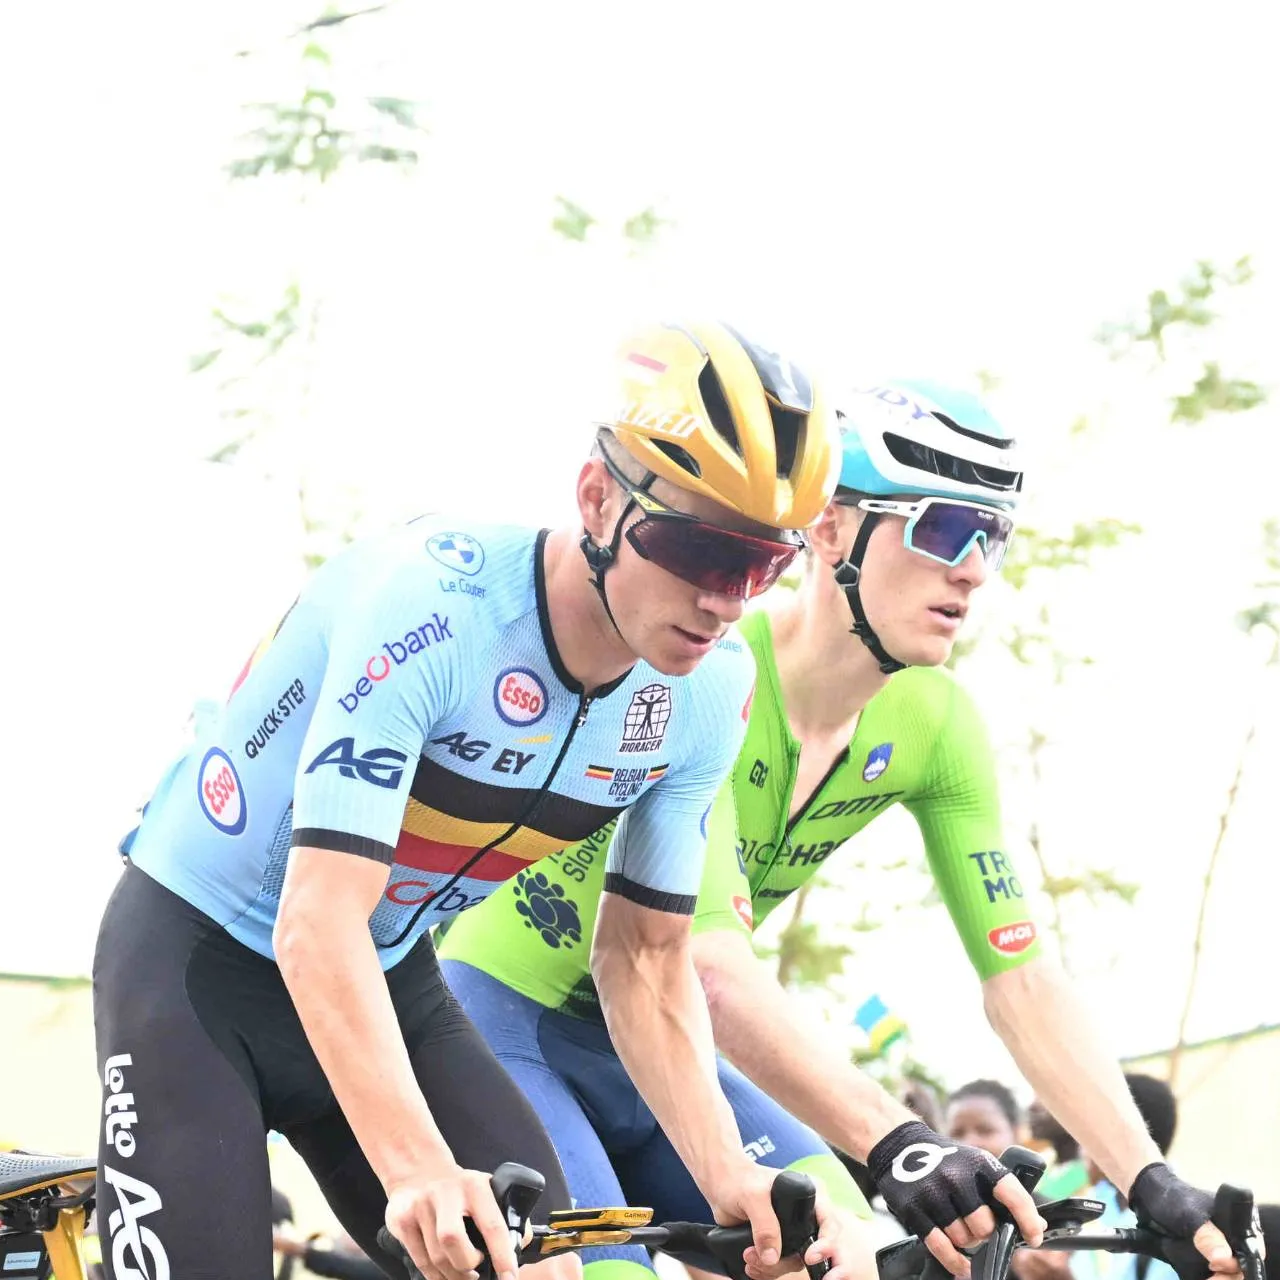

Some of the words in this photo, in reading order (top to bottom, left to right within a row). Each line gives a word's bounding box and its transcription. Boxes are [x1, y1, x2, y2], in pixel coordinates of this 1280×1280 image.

[439, 579, 456, 592] Le
[502, 676, 540, 714] Esso
[429, 731, 491, 762] AG
[491, 748, 537, 774] EY
[619, 739, 663, 753] BIORACER
[304, 737, 408, 790] AG
[613, 768, 649, 783] BELGIAN
[205, 766, 235, 815] Esso
[608, 781, 643, 797] CYCLING
[624, 1212, 647, 1220] GARMIN
